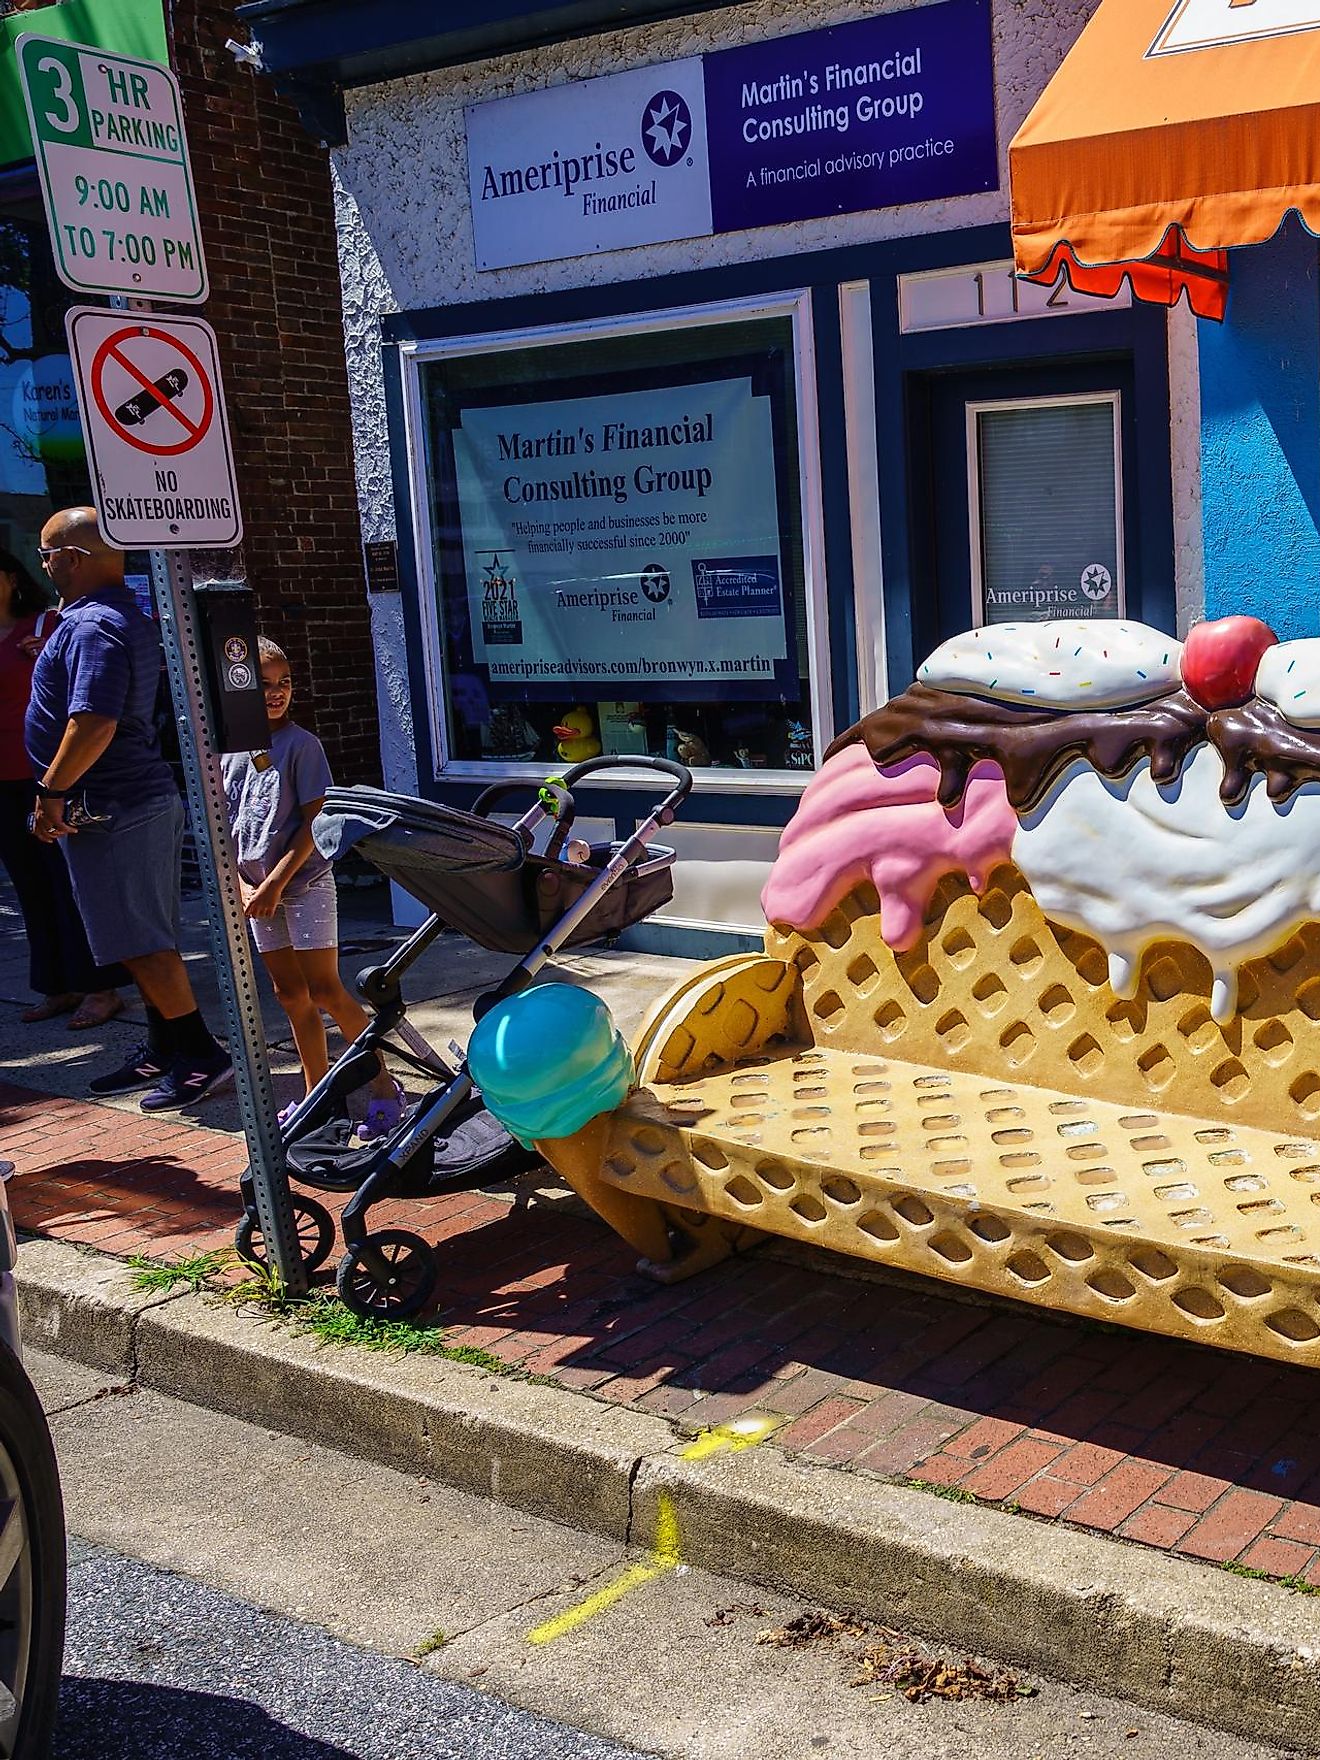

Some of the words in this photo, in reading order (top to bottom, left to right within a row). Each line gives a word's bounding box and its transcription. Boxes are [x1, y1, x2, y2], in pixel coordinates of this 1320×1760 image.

[741, 69, 818, 109] Martin's
[825, 48, 921, 92] Financial
[38, 57, 80, 133] 3
[107, 68, 151, 110] HR
[742, 101, 849, 144] Consulting
[856, 88, 925, 123] Group
[91, 110, 178, 153] PARKING
[481, 142, 636, 200] Ameriprise
[746, 171, 757, 188] A
[760, 157, 821, 187] financial
[825, 149, 884, 180] advisory
[889, 137, 954, 168] practice
[75, 174, 130, 214] 9:00
[140, 187, 170, 219] AM
[582, 181, 657, 217] Financial
[63, 224, 95, 258] TO
[102, 231, 156, 267] 7:00
[163, 239, 195, 271] PM
[22, 379, 70, 401] Karen's
[498, 426, 594, 460] Martin's
[602, 413, 714, 452] Financial
[156, 470, 178, 493] NO
[504, 470, 626, 503] Consulting
[634, 464, 712, 497] Group
[105, 496, 231, 521] SKATEBOARDING
[553, 518, 585, 534] people
[588, 516, 605, 530] and
[609, 514, 660, 529] businesses
[663, 512, 675, 525] be
[679, 511, 707, 524] more
[528, 538, 574, 554] financially
[578, 535, 626, 551] successful
[630, 535, 655, 548] since
[483, 580, 515, 600] 2021
[557, 588, 639, 611] Ameriprise
[716, 586, 739, 596] Estate
[986, 585, 1077, 607] Ameriprise
[482, 600, 498, 616] FIVE
[500, 600, 518, 615] STAR
[612, 608, 656, 621] Financial
[1048, 605, 1094, 617] Financial
[491, 656, 771, 678] ameripriseadvisors.com/bronwyn.x.martin
